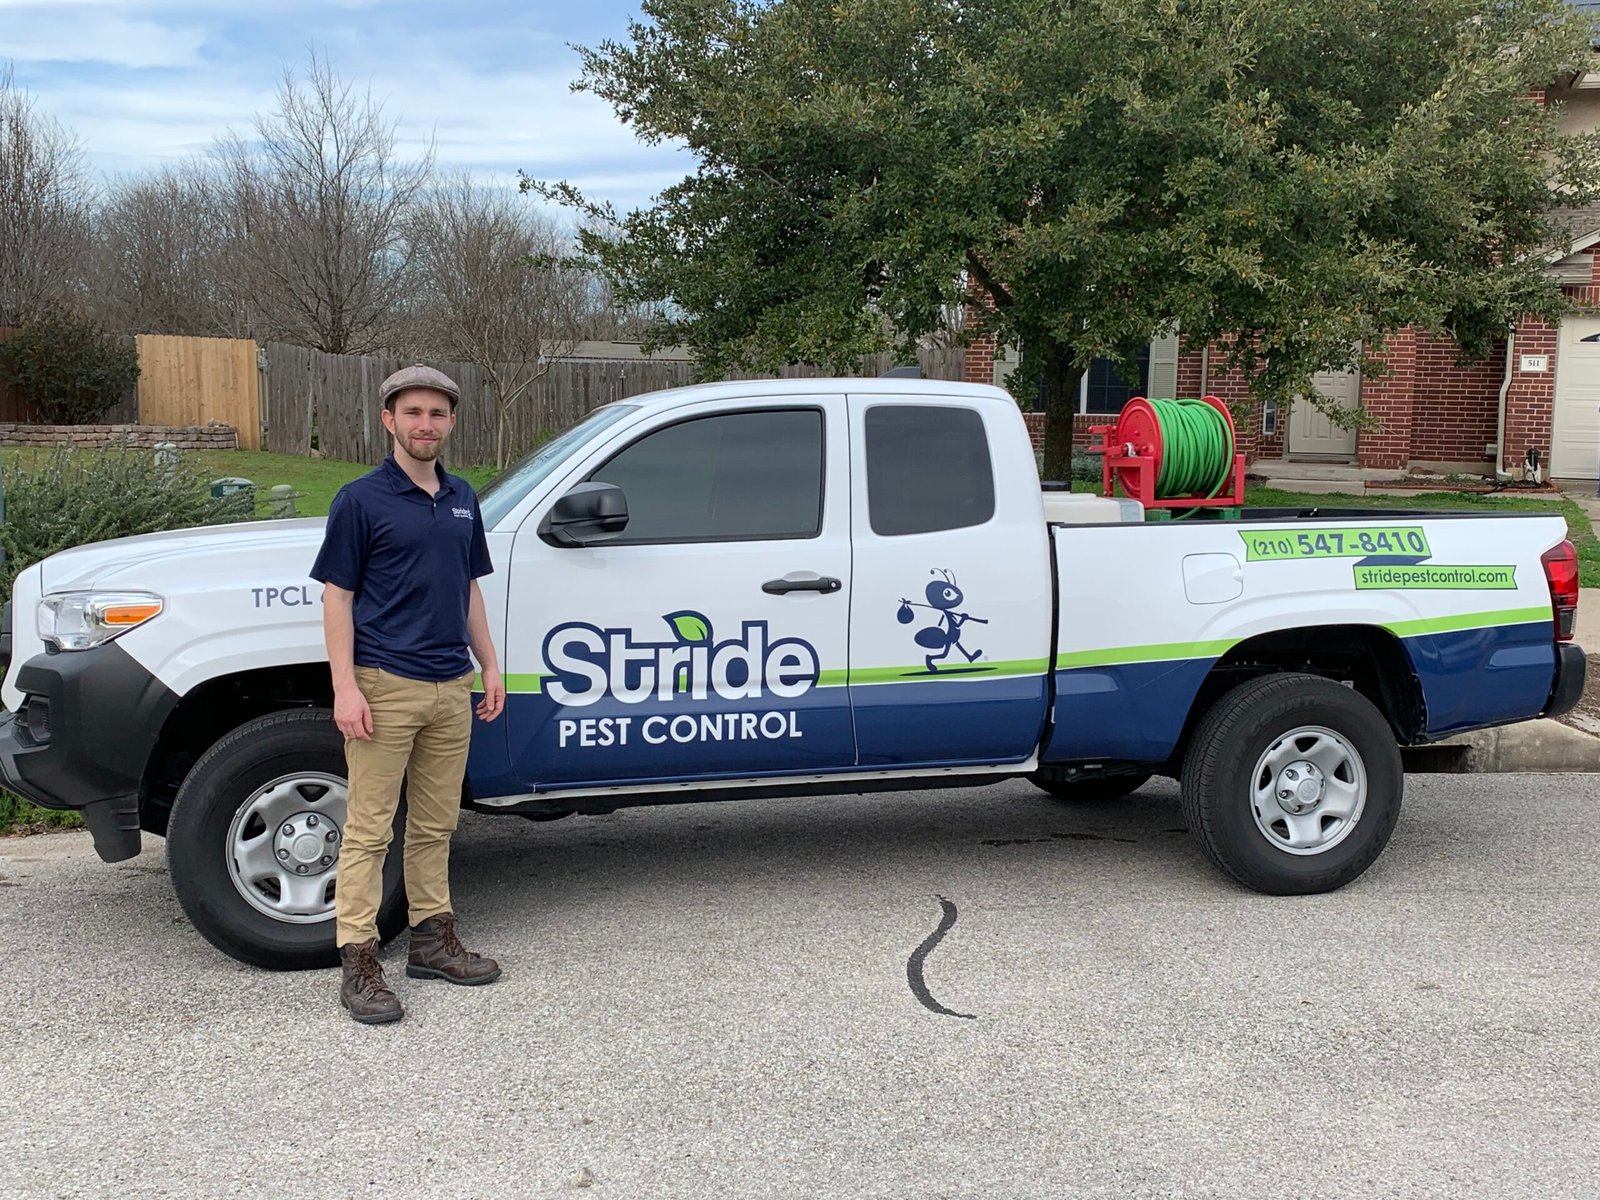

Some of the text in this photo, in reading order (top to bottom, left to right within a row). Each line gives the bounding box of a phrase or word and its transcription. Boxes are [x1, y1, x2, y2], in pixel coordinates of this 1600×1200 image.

[1527, 359, 1540, 367] 511
[1253, 531, 1424, 556] (210) 547-8410
[1361, 569, 1508, 586] stridepestcontrol.com
[251, 586, 313, 608] TPCL
[543, 618, 819, 707] Stride
[558, 711, 803, 748] PEST CONTROL
